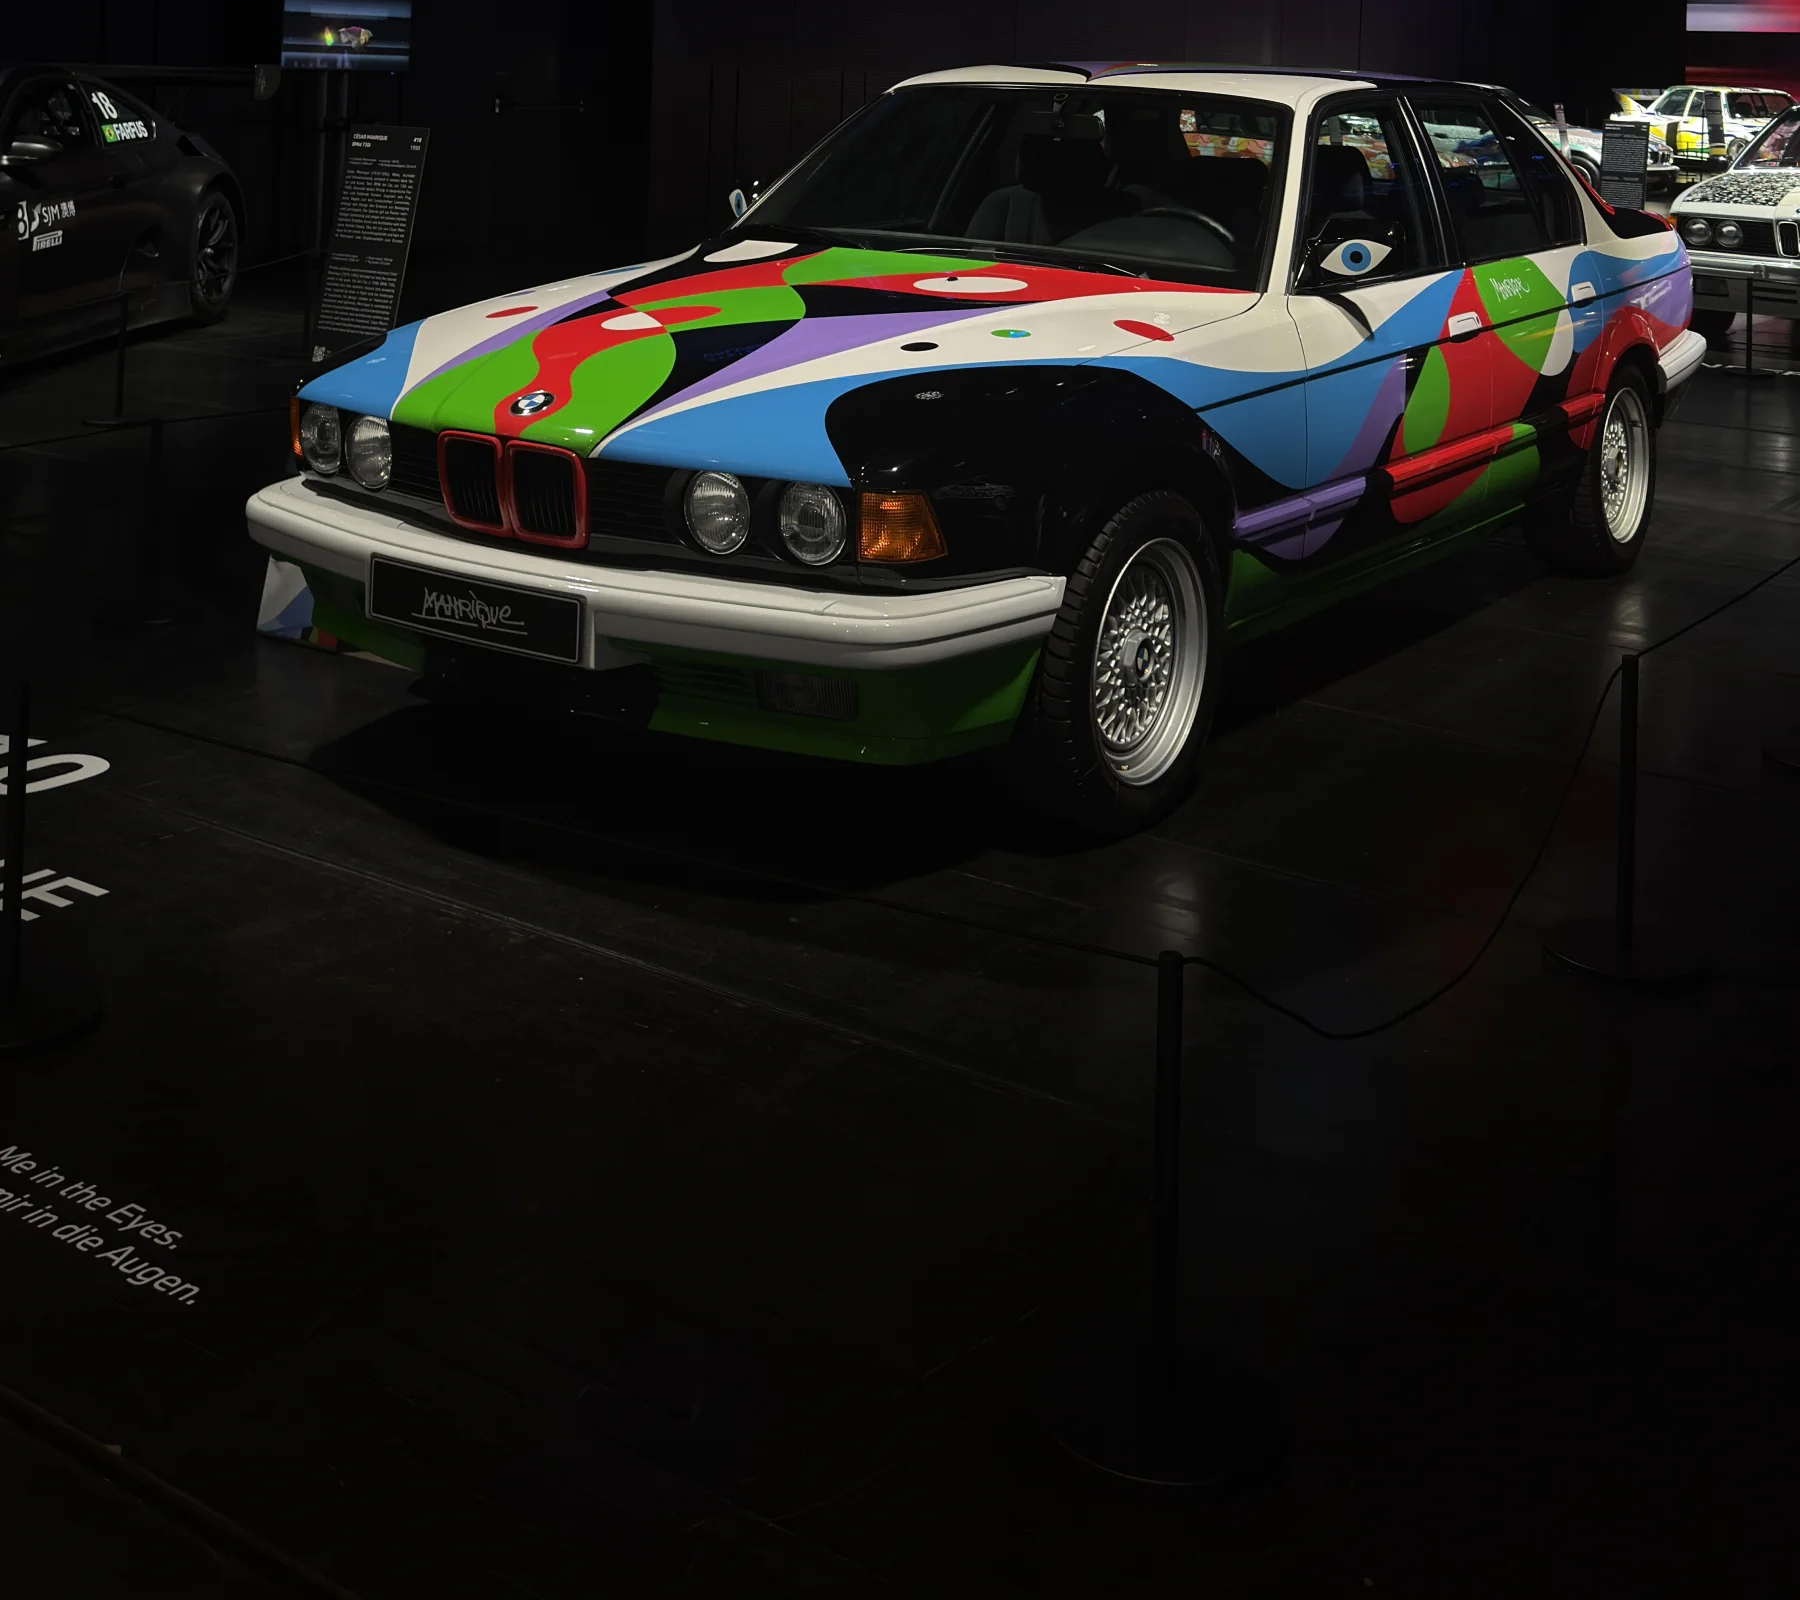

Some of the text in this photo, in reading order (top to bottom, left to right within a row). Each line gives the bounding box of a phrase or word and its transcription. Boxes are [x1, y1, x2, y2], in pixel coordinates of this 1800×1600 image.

[91, 91, 118, 120] 18
[112, 120, 148, 141] FARFUS
[41, 204, 60, 227] SJM
[32, 229, 63, 252] PIRELLI
[0, 1144, 184, 1250] Me in the Eyes.
[21, 1204, 60, 1229] in
[52, 1223, 105, 1253] die
[94, 1245, 200, 1306] Augen.
